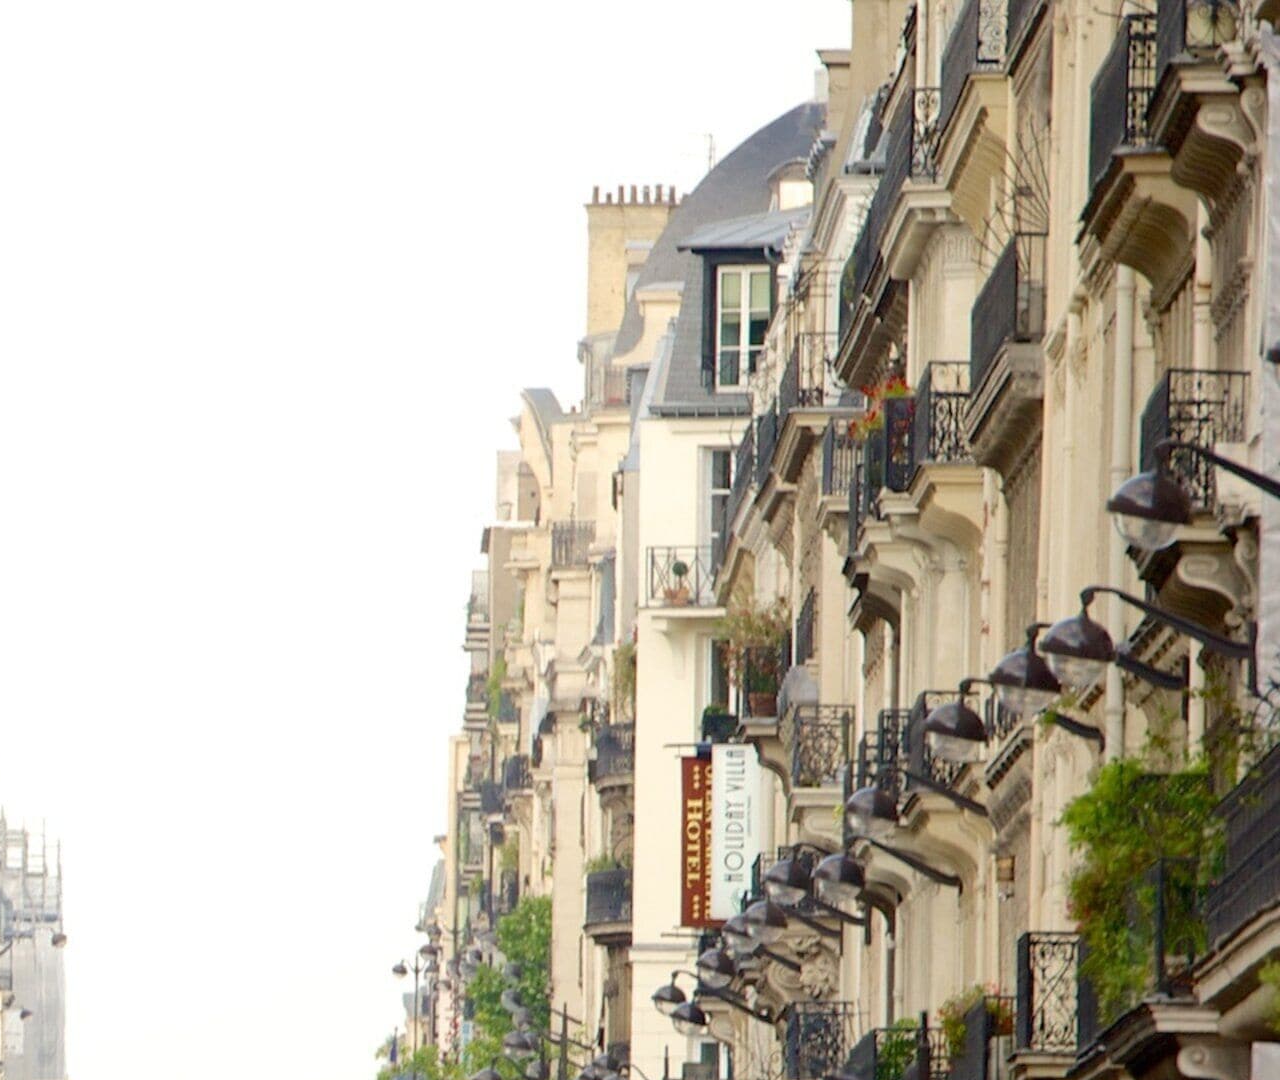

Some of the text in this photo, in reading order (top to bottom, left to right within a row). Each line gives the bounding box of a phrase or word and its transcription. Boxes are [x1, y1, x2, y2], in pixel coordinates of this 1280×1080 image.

[686, 799, 704, 889] HOTEL
[723, 749, 746, 882] HOLIDAY VILLA
